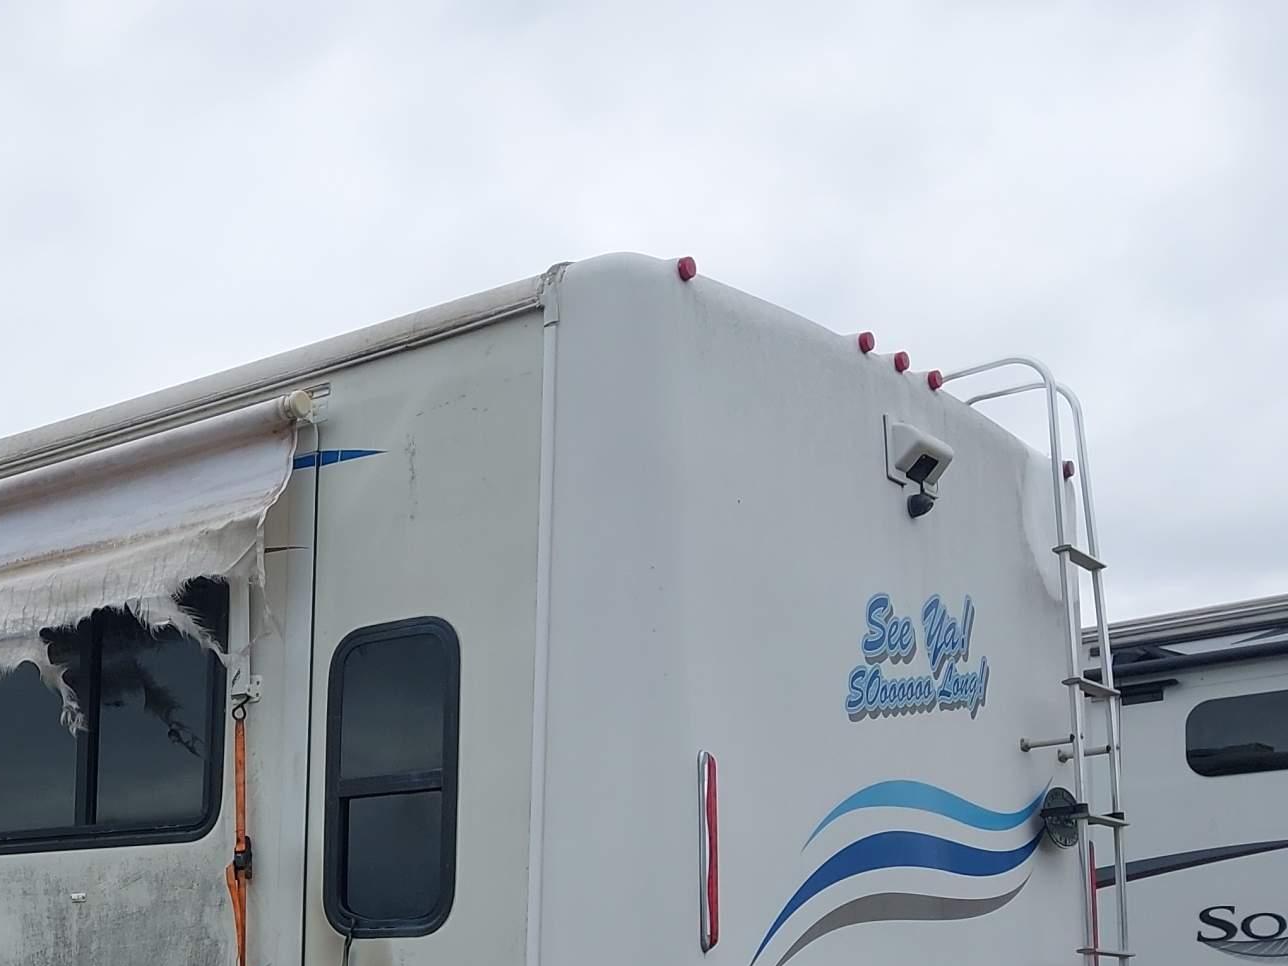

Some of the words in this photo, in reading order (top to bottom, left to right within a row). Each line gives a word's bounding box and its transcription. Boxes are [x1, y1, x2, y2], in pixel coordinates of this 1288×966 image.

[862, 592, 917, 665] See
[922, 593, 975, 680] Ya!
[938, 655, 990, 720] Long!
